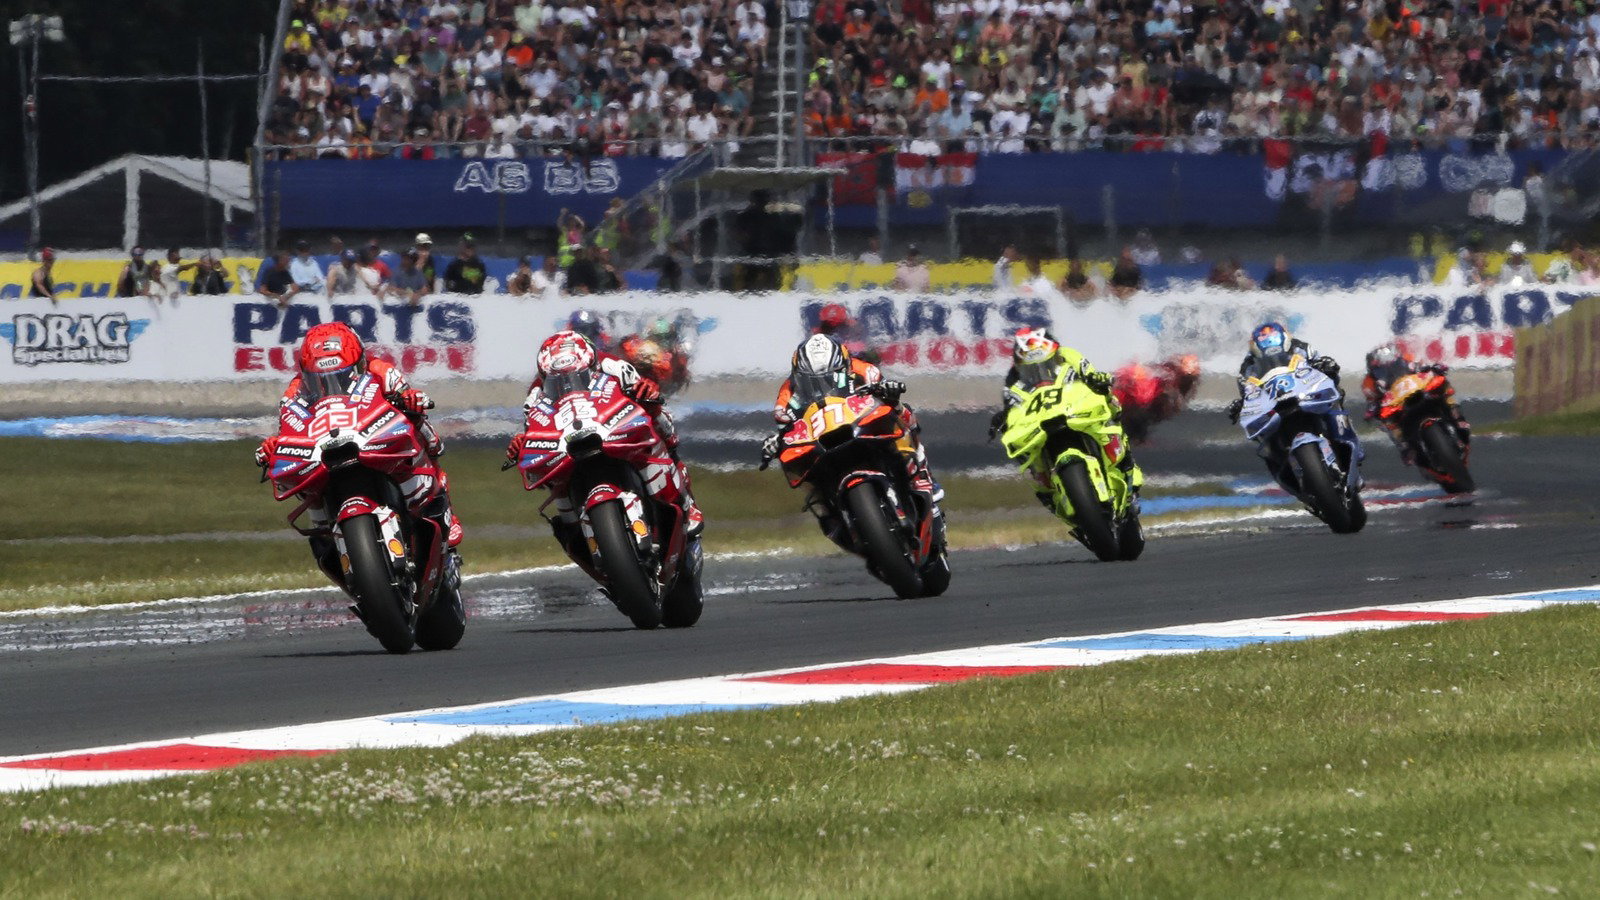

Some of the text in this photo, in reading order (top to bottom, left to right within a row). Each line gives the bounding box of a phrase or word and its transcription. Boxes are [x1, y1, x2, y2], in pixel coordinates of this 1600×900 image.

[14, 313, 129, 348] DRAG
[232, 303, 476, 344] PARTS
[318, 358, 339, 368] SHOEI
[1025, 388, 1063, 416] 49
[360, 411, 395, 437] Lenovo
[603, 404, 634, 429] Lenovo
[810, 403, 844, 438] 37
[276, 446, 312, 457] Lenovo
[525, 440, 558, 449] Lenovo
